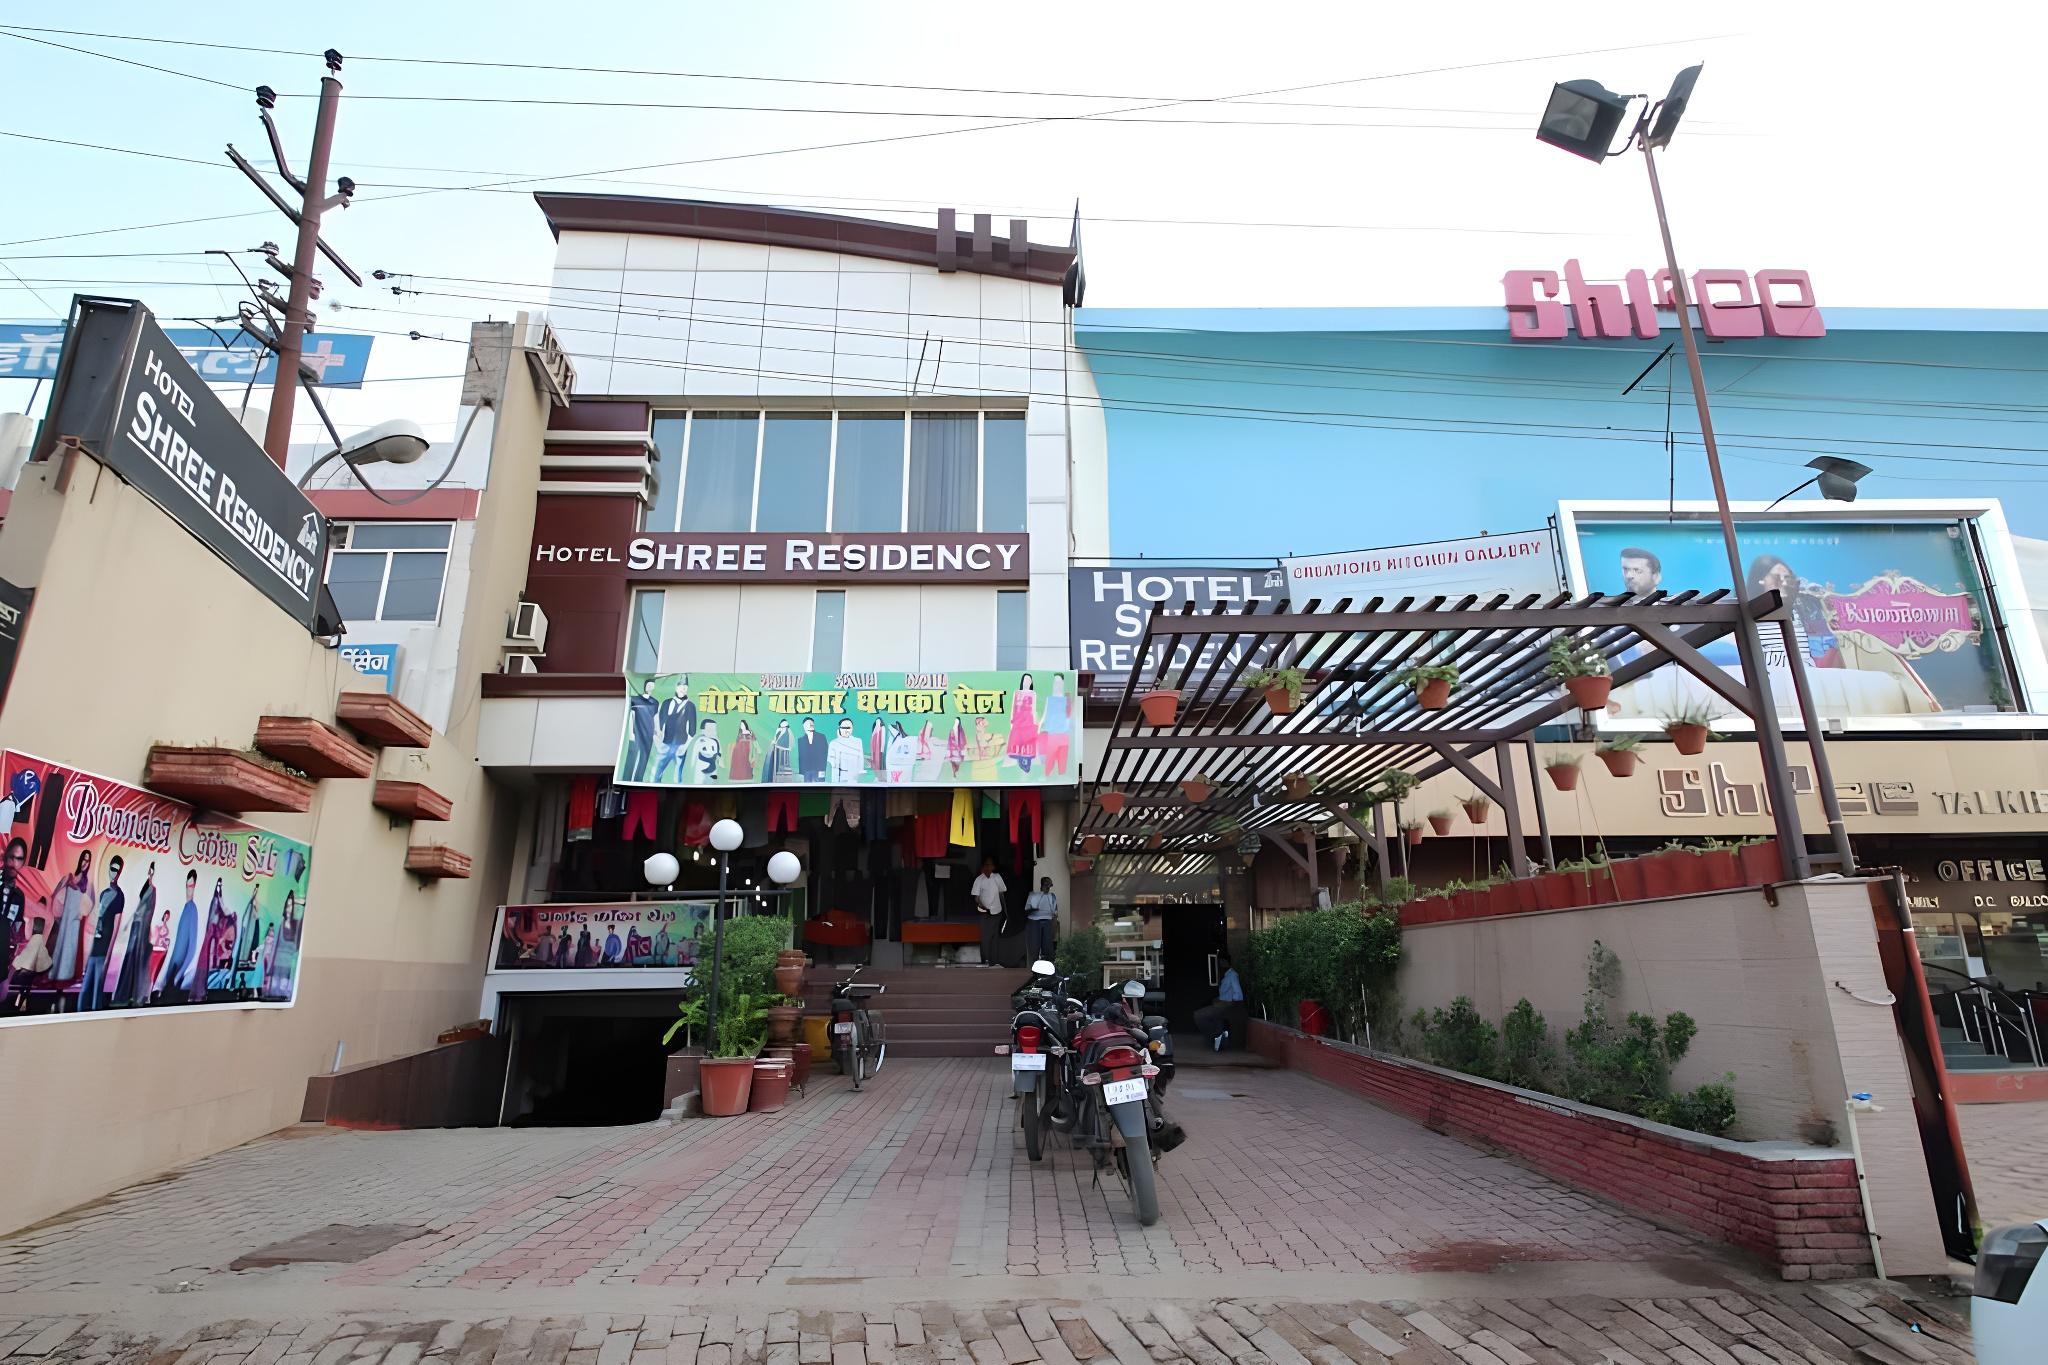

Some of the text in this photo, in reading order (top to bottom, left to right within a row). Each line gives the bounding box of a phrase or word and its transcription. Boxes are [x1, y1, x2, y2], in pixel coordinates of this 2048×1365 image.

[144, 349, 196, 427] HOTEL
[131, 391, 315, 594] SHREE RESIDENCY
[535, 538, 1022, 572] HOTEL SHREE RESIDENCY
[1093, 571, 1272, 602] HOTEL
[1938, 859, 2047, 881] OFFICE
